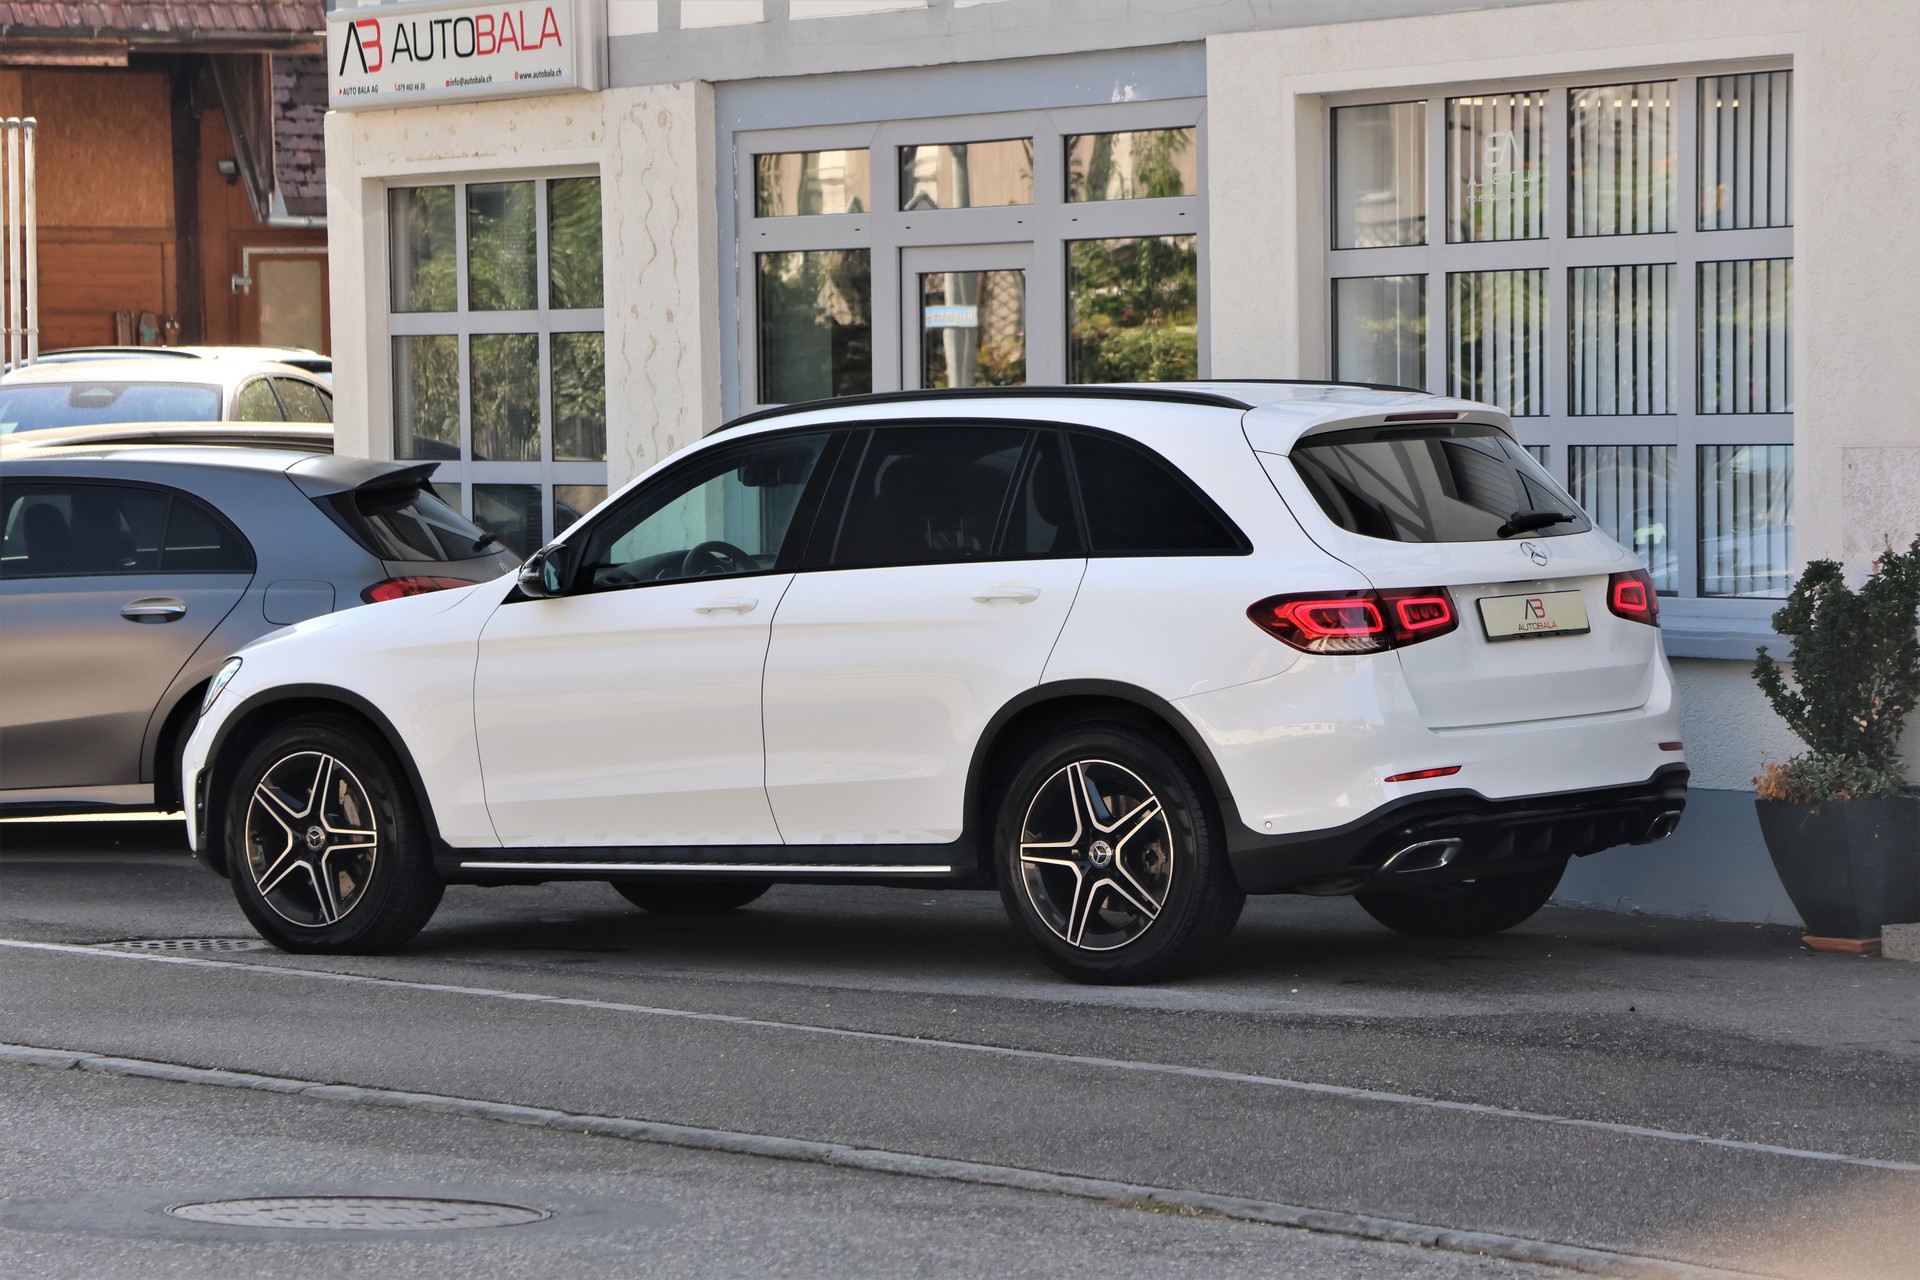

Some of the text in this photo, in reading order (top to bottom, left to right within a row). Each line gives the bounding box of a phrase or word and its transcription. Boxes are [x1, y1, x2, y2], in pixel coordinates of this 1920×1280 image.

[391, 6, 562, 63] AUTOBALA
[519, 67, 562, 80] www.autobala.ch
[449, 75, 493, 87] info@autobala.ch
[343, 85, 379, 96] AUTO BALA AG
[1518, 621, 1557, 630] AUTOBALA
